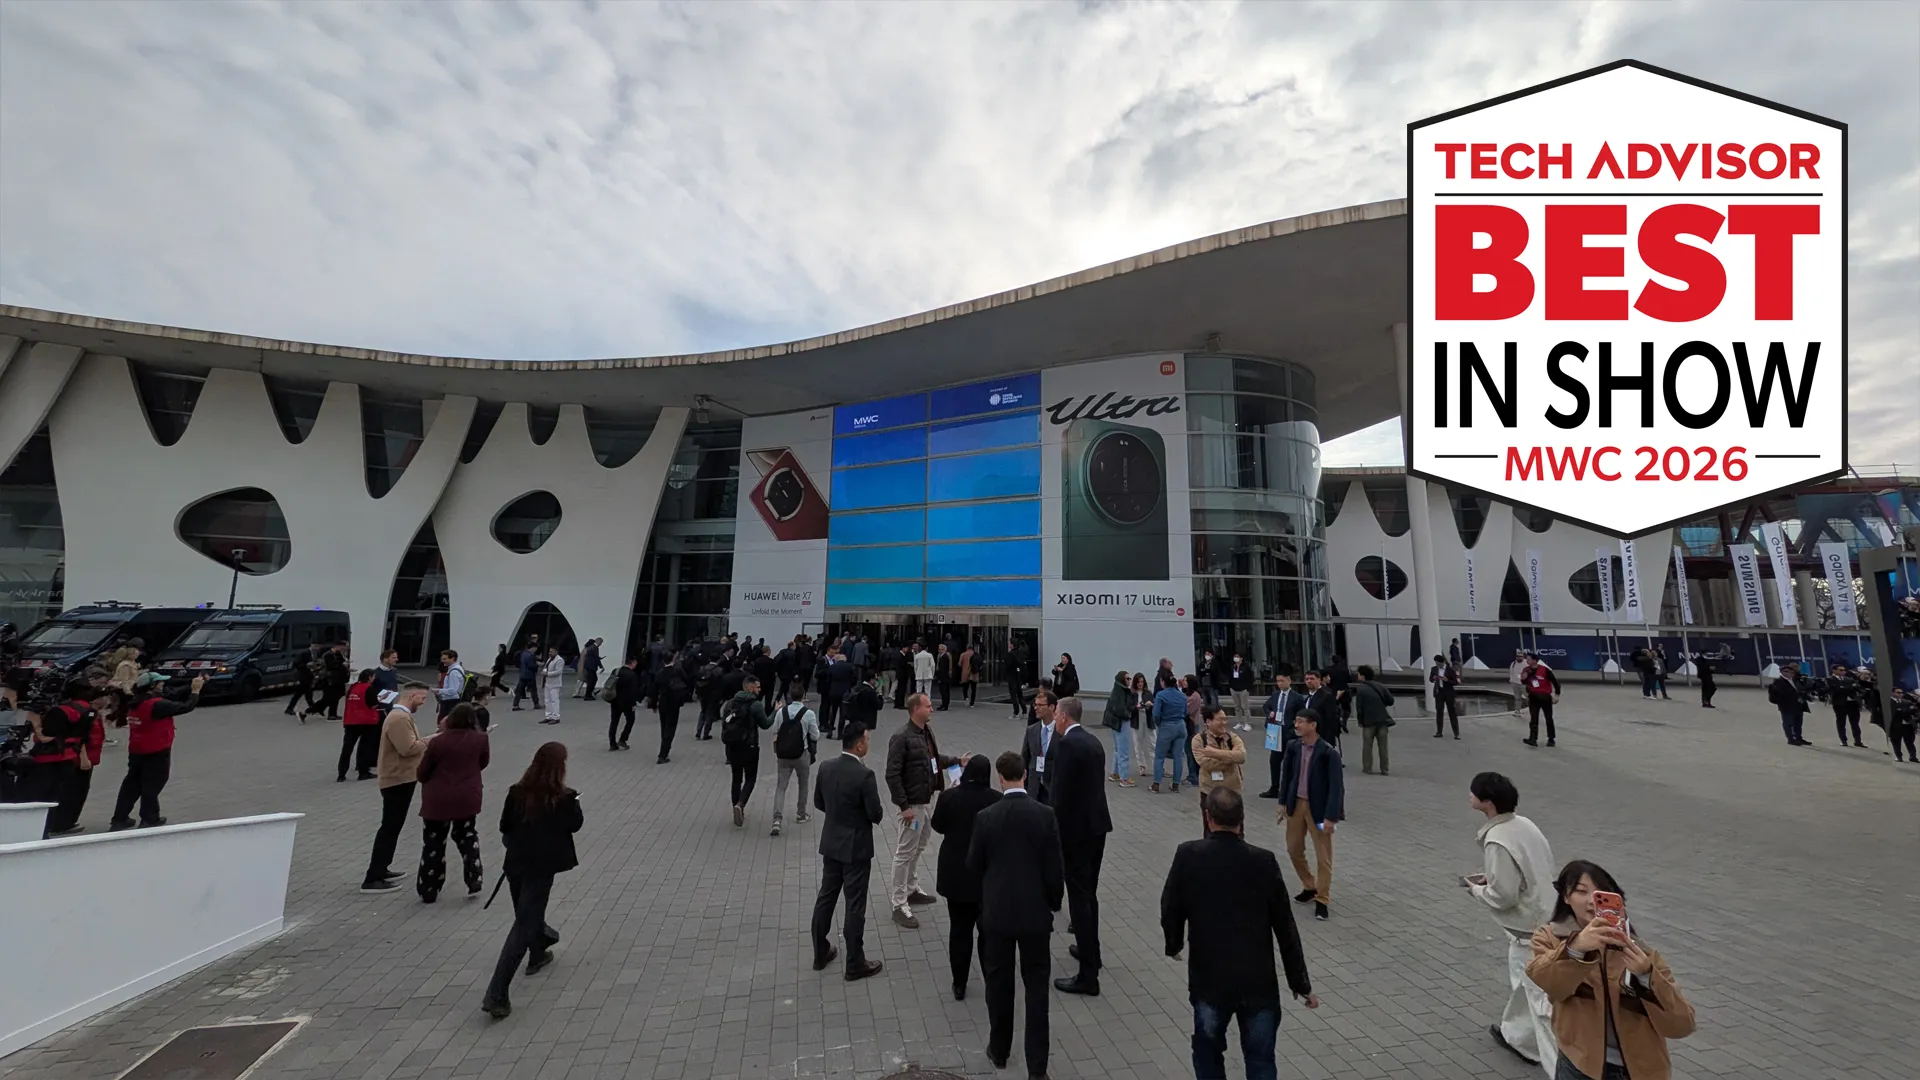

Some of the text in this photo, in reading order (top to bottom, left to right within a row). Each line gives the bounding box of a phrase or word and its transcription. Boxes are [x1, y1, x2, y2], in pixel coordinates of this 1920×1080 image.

[1045, 391, 1181, 425] Ultra
[853, 414, 879, 425] MWC
[744, 591, 812, 600] HUAWEI Mate X7
[1124, 594, 1138, 605] 17
[1142, 594, 1175, 606] Ultra
